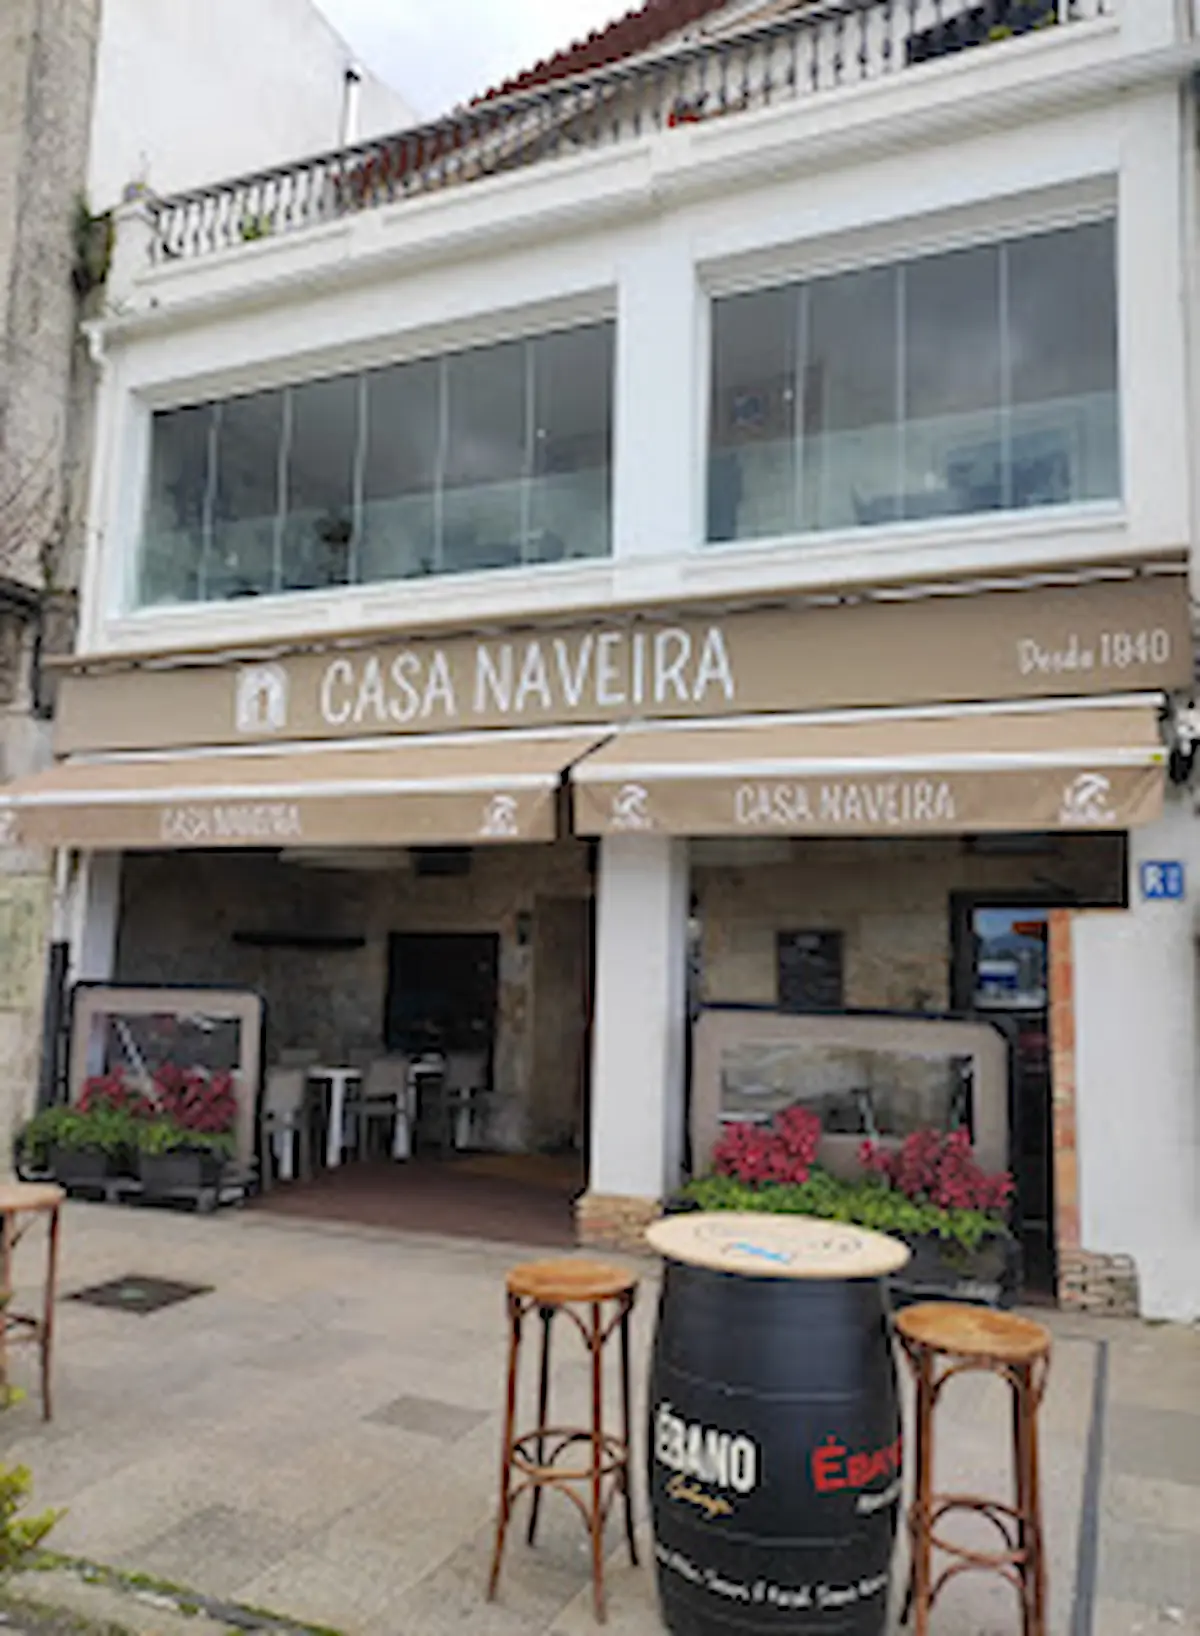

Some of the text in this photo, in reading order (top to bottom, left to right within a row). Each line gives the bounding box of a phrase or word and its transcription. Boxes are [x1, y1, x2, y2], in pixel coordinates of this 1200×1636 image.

[1100, 628, 1171, 668] 1840
[320, 626, 736, 725] CASA NAVEIRA
[734, 780, 955, 825] CASA NAVEIRA
